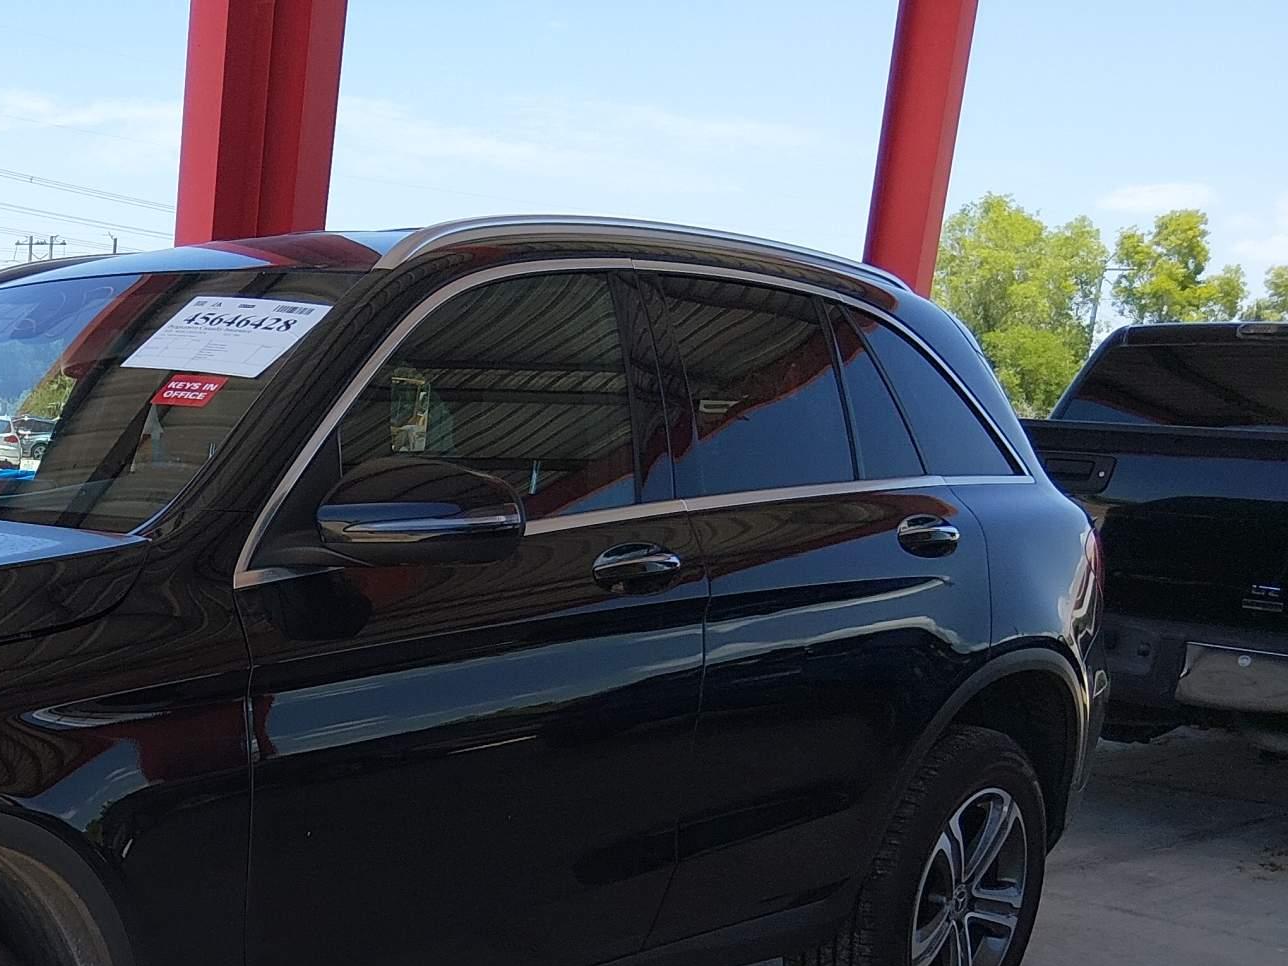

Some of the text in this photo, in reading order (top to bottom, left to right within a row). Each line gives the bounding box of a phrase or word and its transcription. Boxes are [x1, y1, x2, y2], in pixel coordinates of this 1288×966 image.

[183, 312, 298, 332] 45646428
[167, 381, 218, 391] KEYS IN
[162, 390, 208, 400] OFFICE
